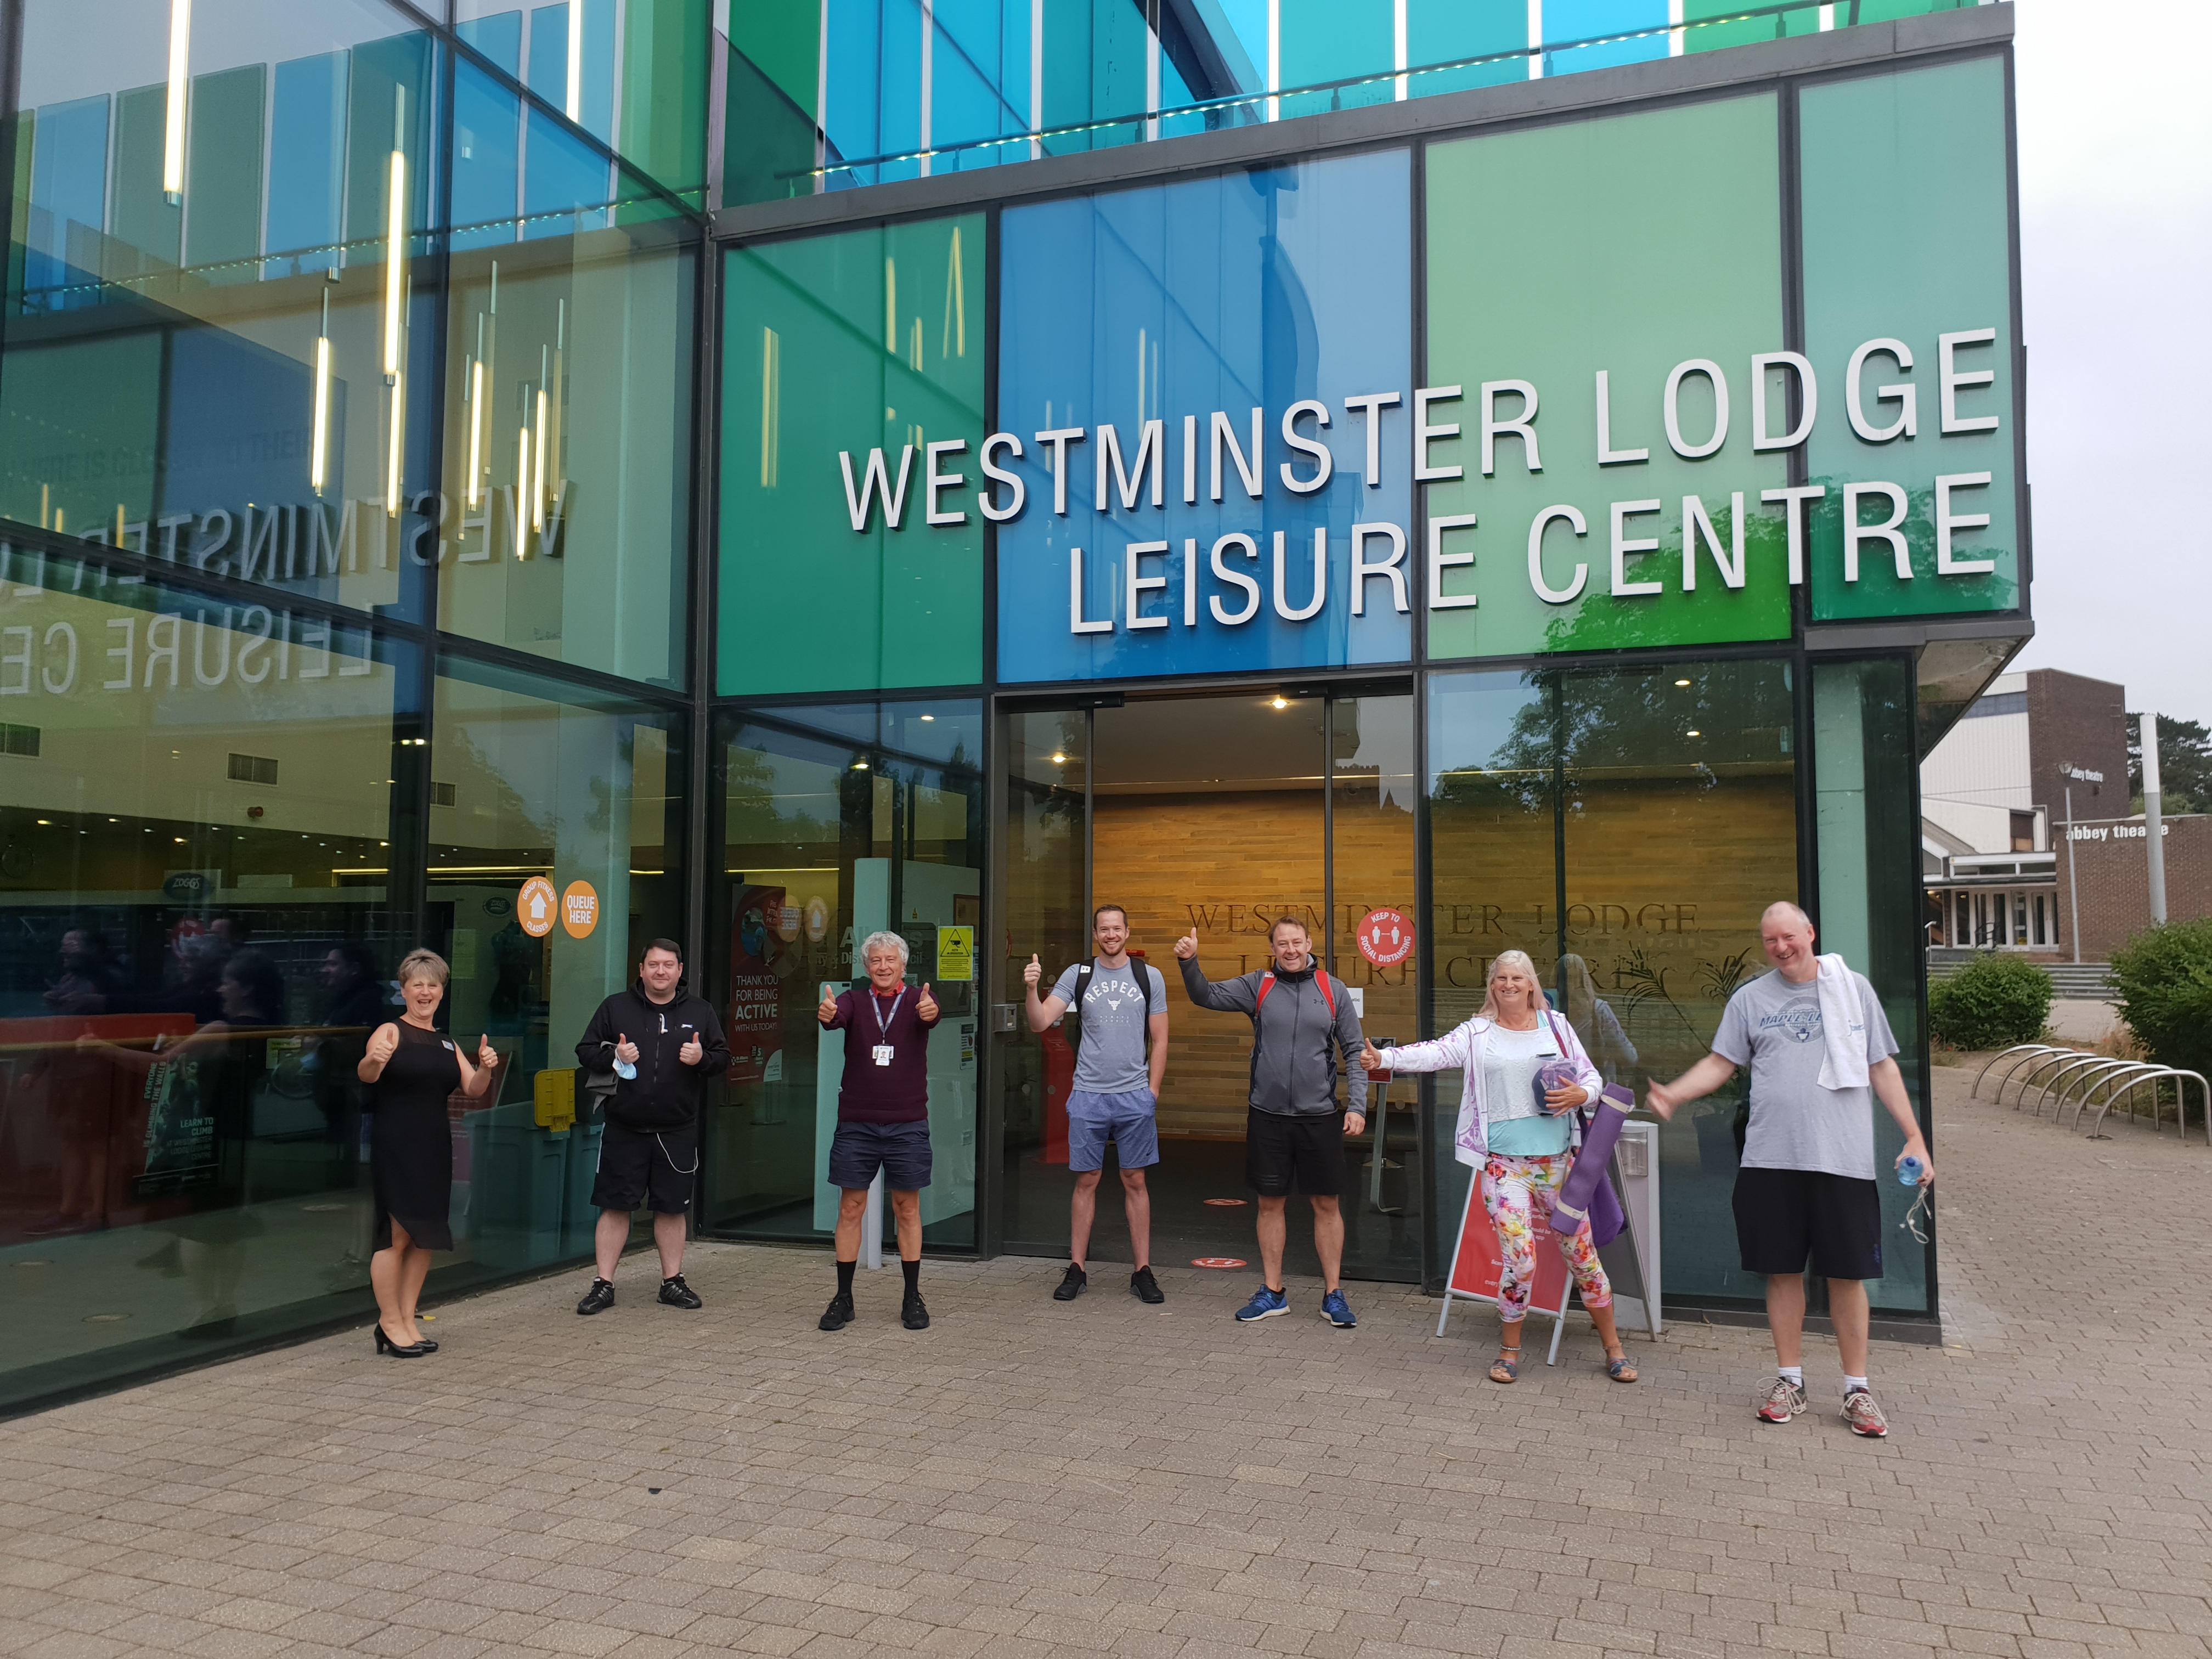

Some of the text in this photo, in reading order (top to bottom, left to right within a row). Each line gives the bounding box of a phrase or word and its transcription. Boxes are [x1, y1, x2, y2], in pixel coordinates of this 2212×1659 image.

[839, 328, 2000, 533] WESTMINSTER LODGE
[1070, 471, 1996, 636] LEISURE CENTRE
[2113, 824, 2169, 839] theae
[172, 877, 201, 889] ZOGGS
[522, 881, 555, 902] GROUP FITNESS
[567, 895, 595, 911] QUEUE
[569, 910, 592, 924] HERE
[1370, 912, 1401, 923] KEEP TO
[526, 921, 549, 933] CLASSES
[1361, 935, 1412, 963] SOCIAL DISTANCING
[736, 974, 778, 986] THANK YOU
[736, 988, 778, 1001] FOR BEING
[1084, 980, 1144, 1003] RESPECT
[735, 1003, 778, 1020] ACTIVE
[735, 1024, 750, 1032] WITH
[751, 1023, 758, 1031] US
[144, 1062, 158, 1100] EVERYONE
[180, 1116, 214, 1129] LEARN TO
[191, 1126, 213, 1136] CLIMB
